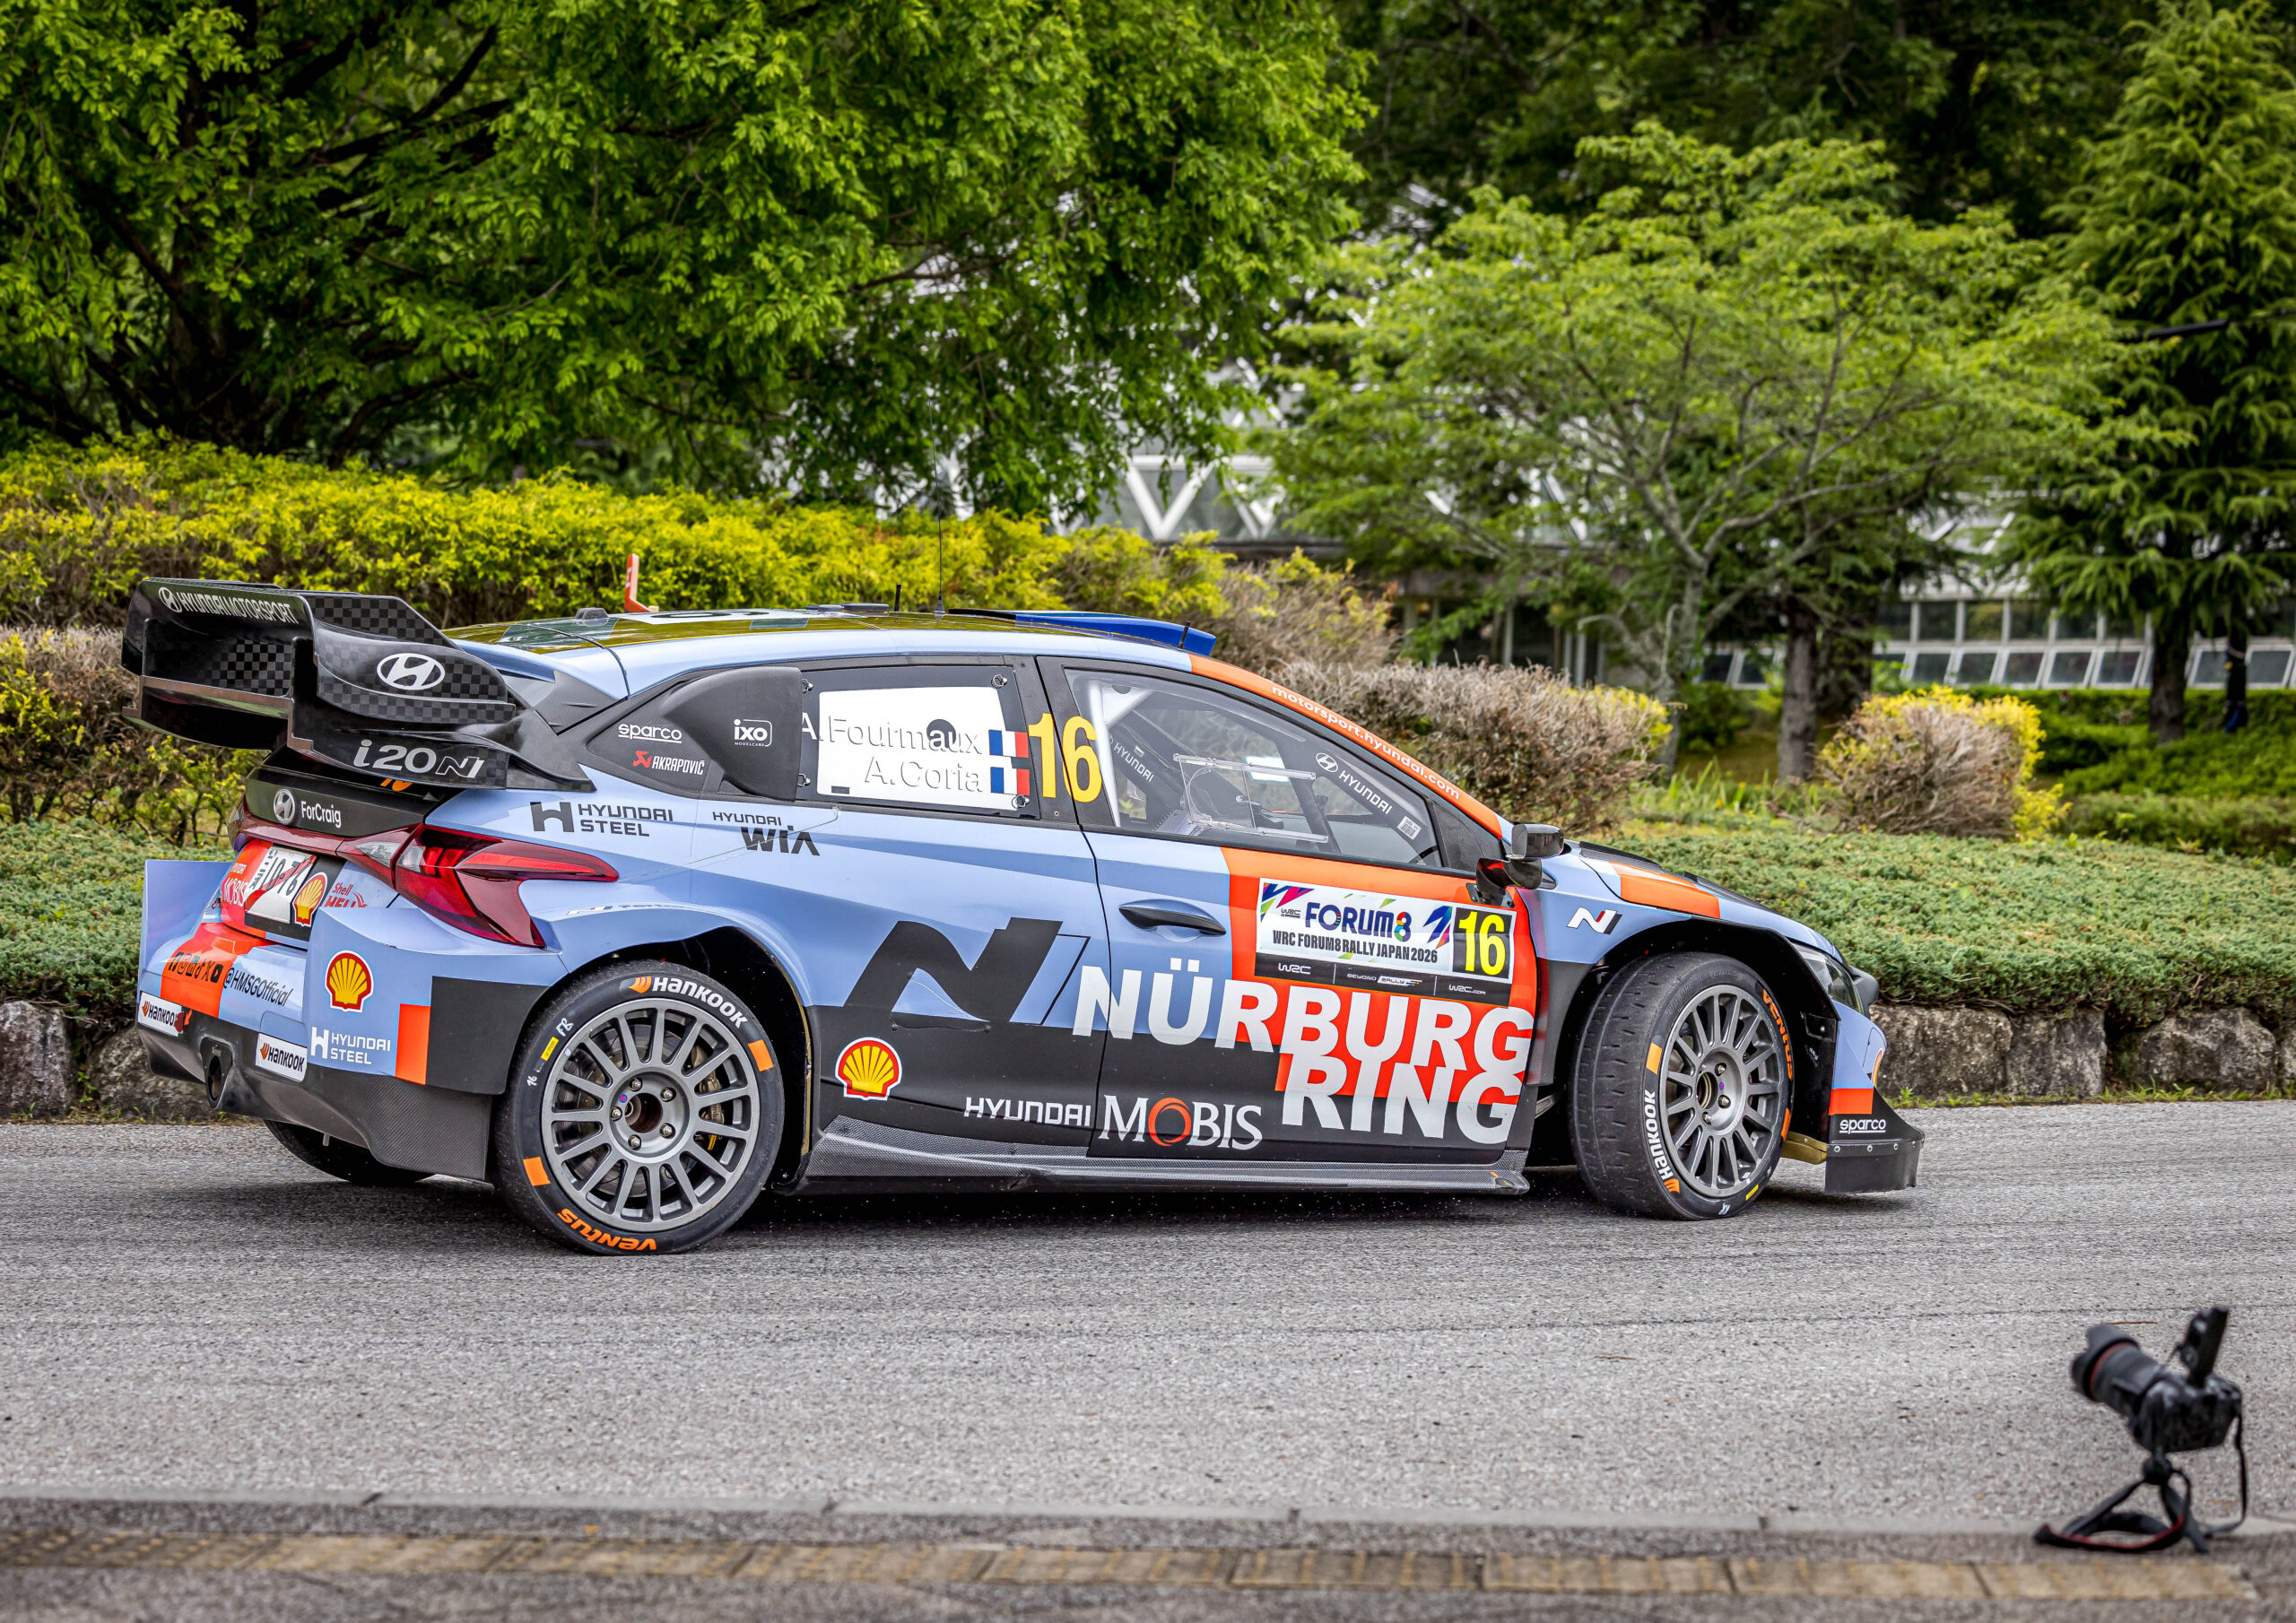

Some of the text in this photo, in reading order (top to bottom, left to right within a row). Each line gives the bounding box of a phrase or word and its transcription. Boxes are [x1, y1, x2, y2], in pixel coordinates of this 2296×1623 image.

[618, 724, 683, 740] sparco
[734, 718, 768, 742] ixo
[1272, 685, 1460, 800] motorsport.hyundai.com
[1028, 712, 1102, 803] 16
[1113, 742, 1154, 783] HYUNDAI
[1338, 769, 1392, 815] HYUNDAI
[300, 800, 342, 829] ForCraig
[578, 803, 673, 821] HYUNDAI
[712, 812, 782, 826] HYUNDAI
[580, 820, 649, 837] STEEL
[332, 882, 353, 896] Shell
[1305, 901, 1412, 942] FORUM8
[1273, 930, 1438, 963] WRC FORUM8 RALLY JAPAN 2026
[1458, 911, 1506, 976] 16
[1278, 962, 1311, 975] WRC
[1346, 973, 1377, 981] BEYOND
[149, 1003, 178, 1025] Hankoo
[1073, 957, 1535, 1077] NÜRBURG
[331, 1034, 391, 1052] HYUNDAI
[331, 1048, 371, 1065] STEEL
[1282, 1053, 1523, 1144] RING
[963, 1094, 1263, 1150] HYUNDAI MOBIS
[1839, 1119, 1887, 1133] sparco
